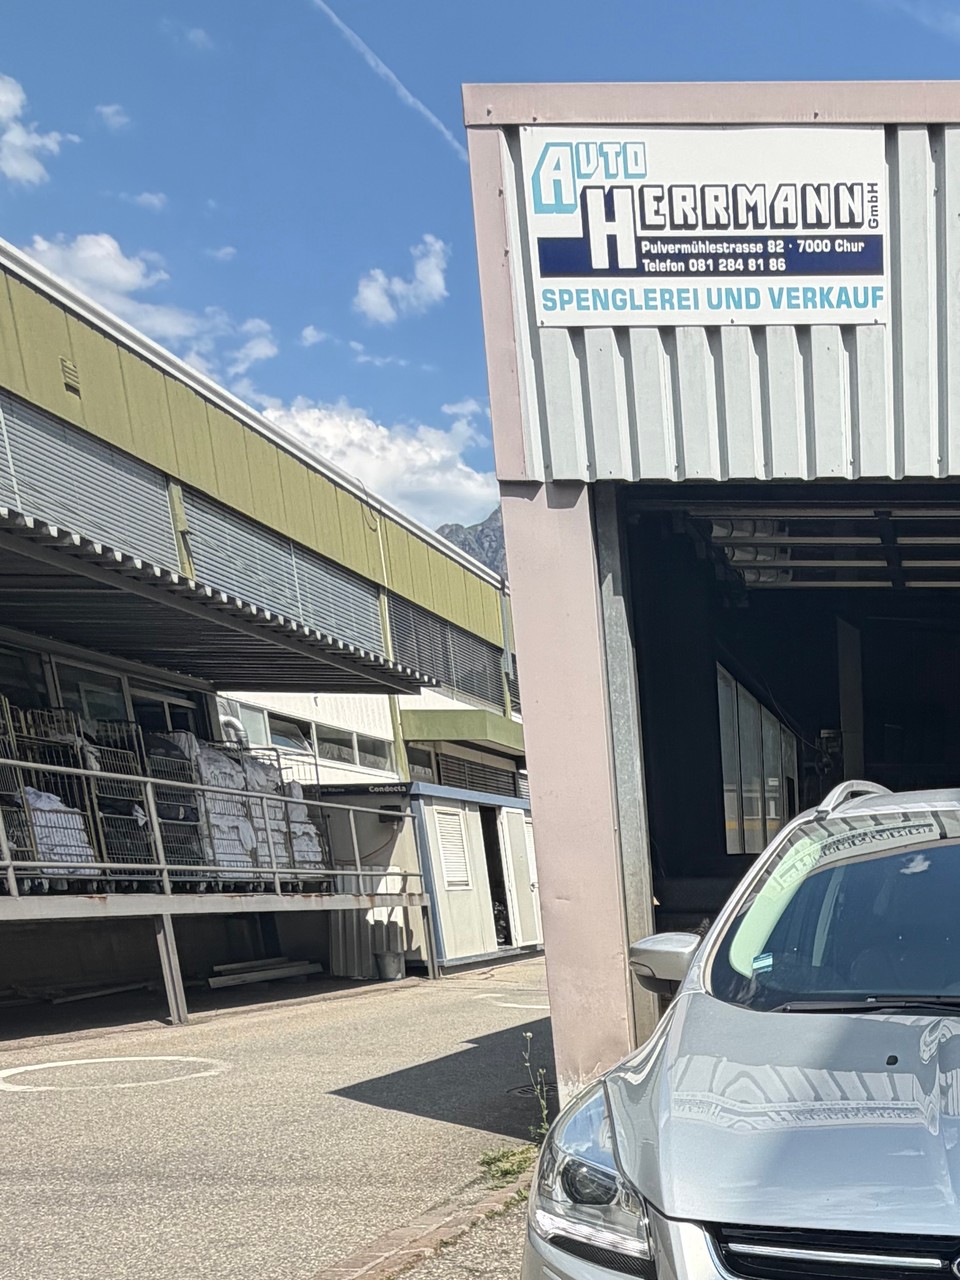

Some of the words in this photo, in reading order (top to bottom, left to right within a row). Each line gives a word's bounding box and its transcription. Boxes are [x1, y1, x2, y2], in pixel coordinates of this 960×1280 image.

[532, 141, 647, 215] AUTO
[868, 182, 879, 229] GmbH
[580, 183, 864, 269] HERRMANN
[641, 240, 763, 255] Pulvermühlestrasse
[767, 240, 784, 253] 82
[797, 240, 830, 253] 7000
[834, 239, 865, 253] Chur
[643, 258, 685, 272] Telefon
[689, 258, 713, 272] 081
[719, 258, 743, 272] 284
[748, 259, 764, 272] 81
[769, 258, 786, 271] 86
[542, 287, 700, 311] SPENGLEREI
[707, 287, 761, 309] UND
[768, 286, 884, 309] VERKAUF
[368, 785, 406, 793] Condecta
